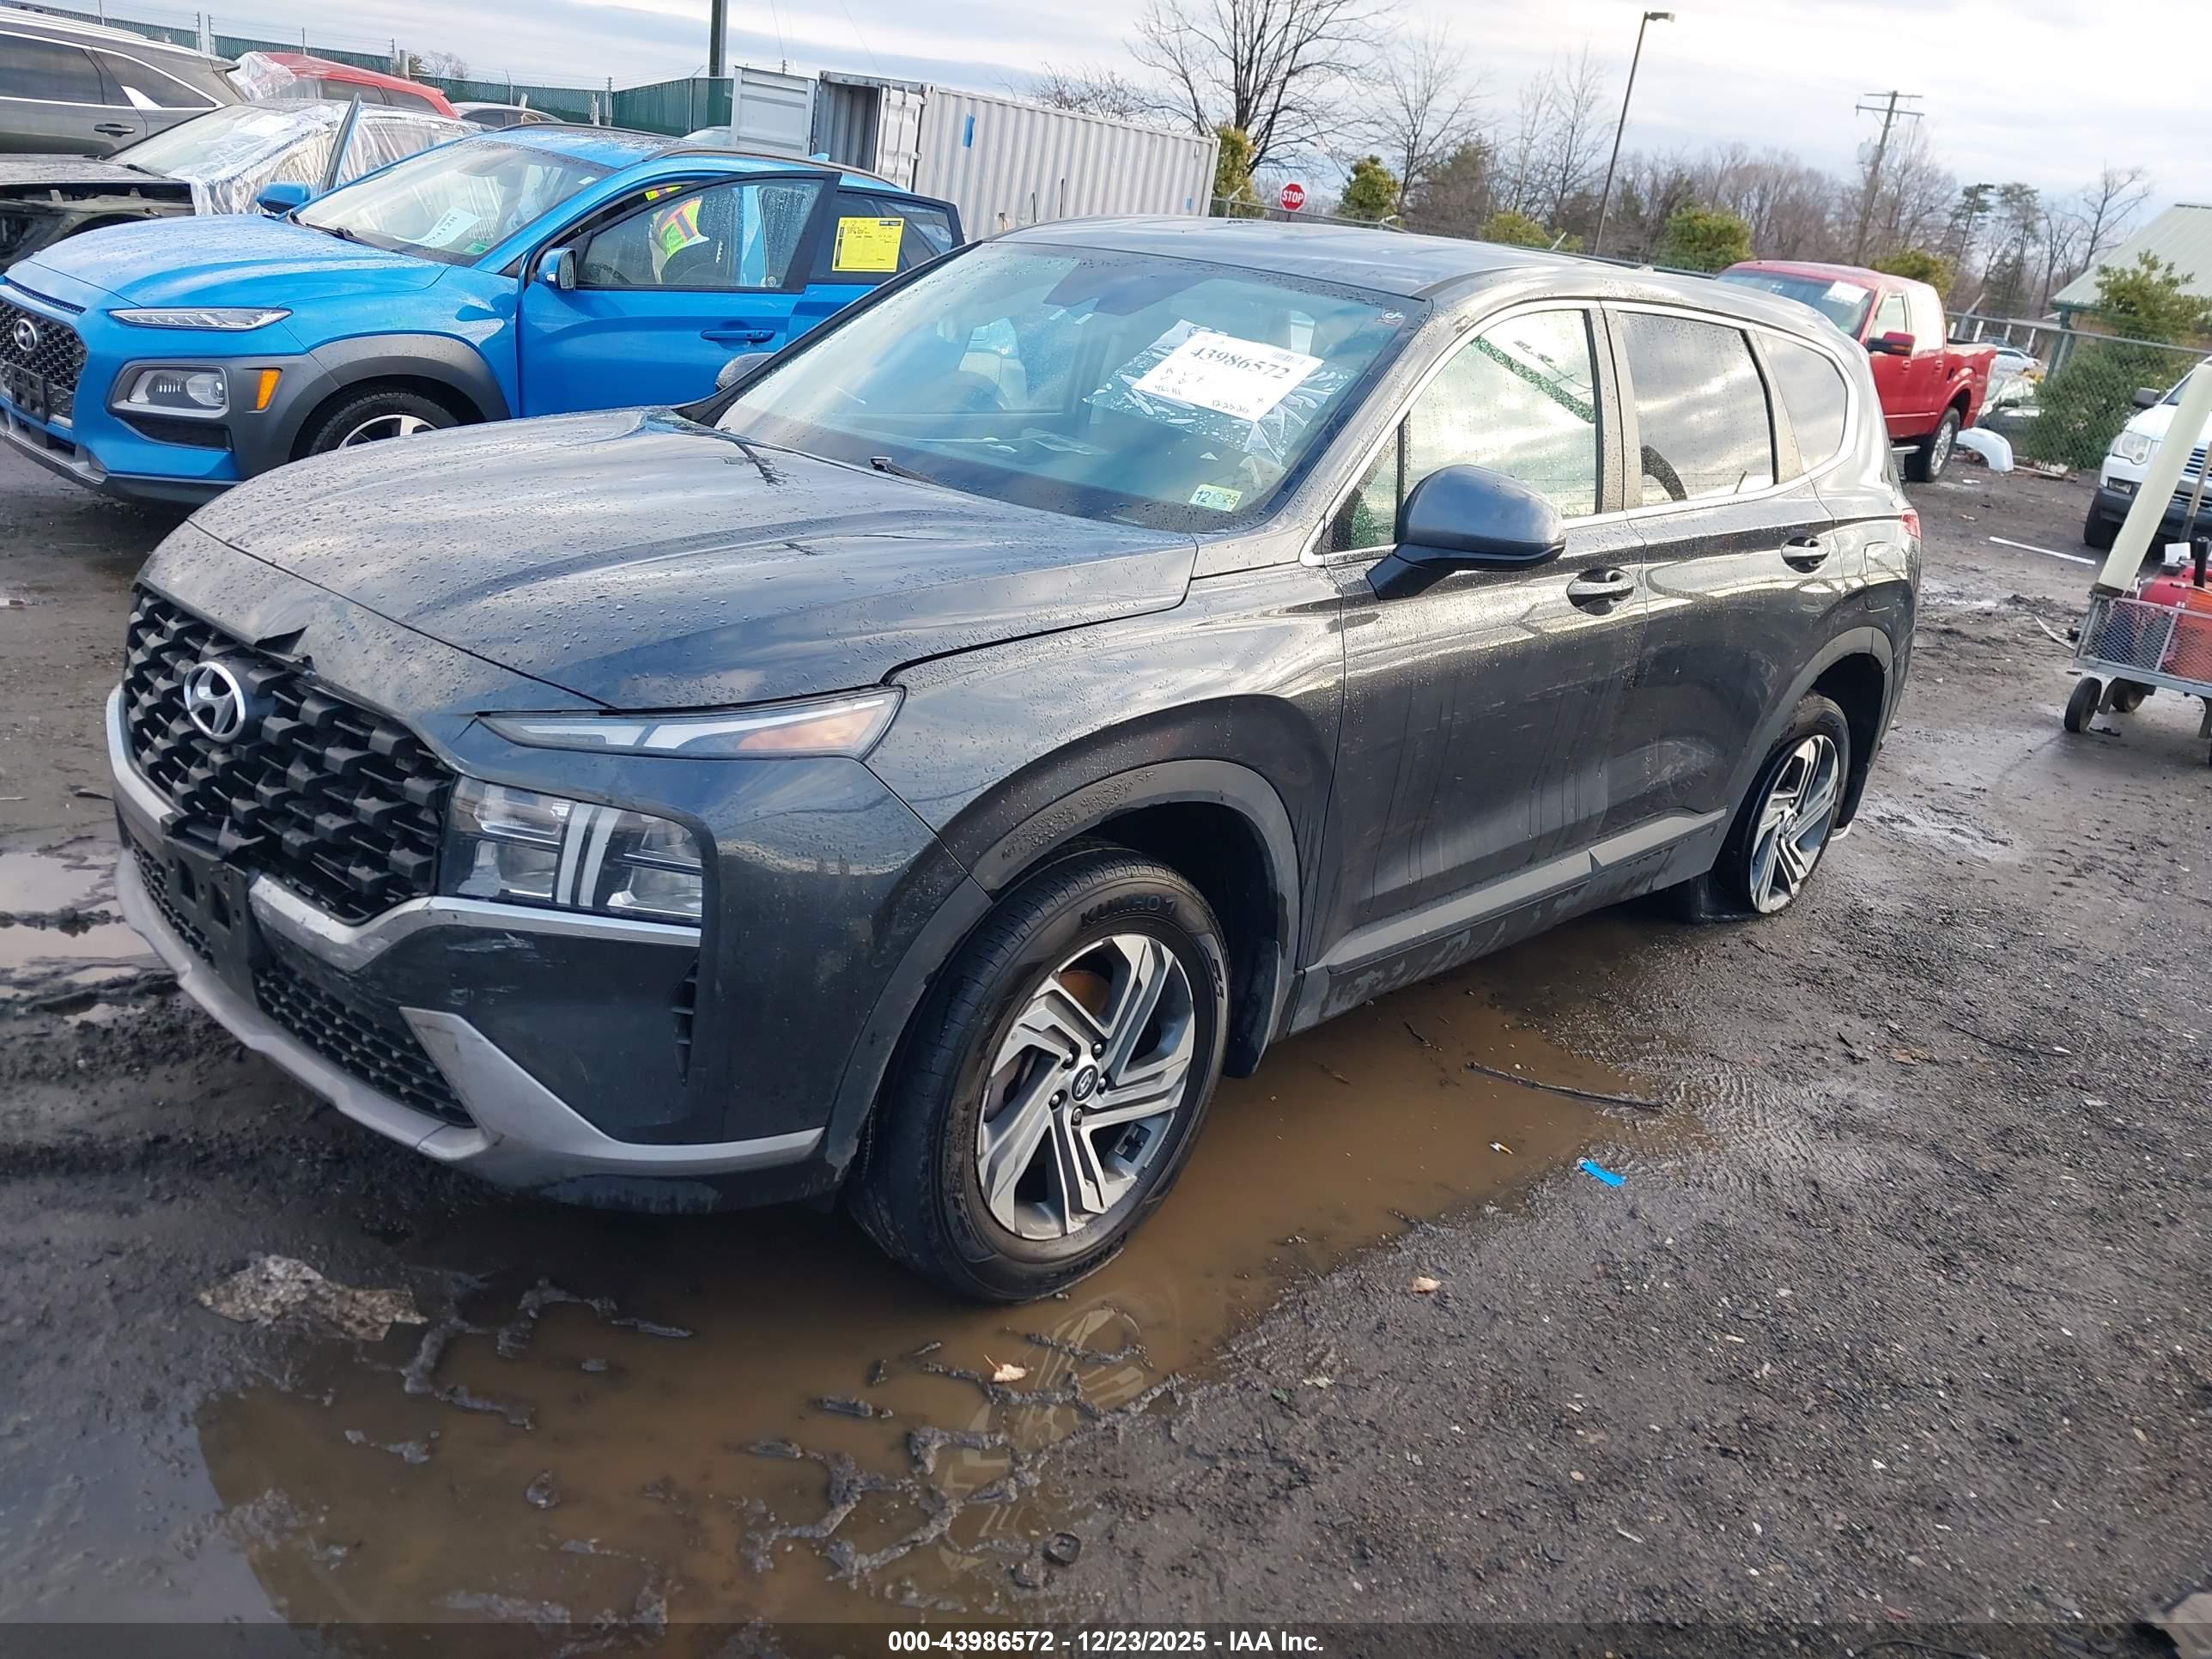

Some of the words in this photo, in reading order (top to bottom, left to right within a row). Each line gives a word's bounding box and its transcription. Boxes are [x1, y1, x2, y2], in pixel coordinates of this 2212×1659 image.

[1282, 190, 1304, 204] STOP
[1189, 347, 1291, 380] 43986572
[1196, 489, 1212, 503] 12
[1223, 494, 1238, 505] 25
